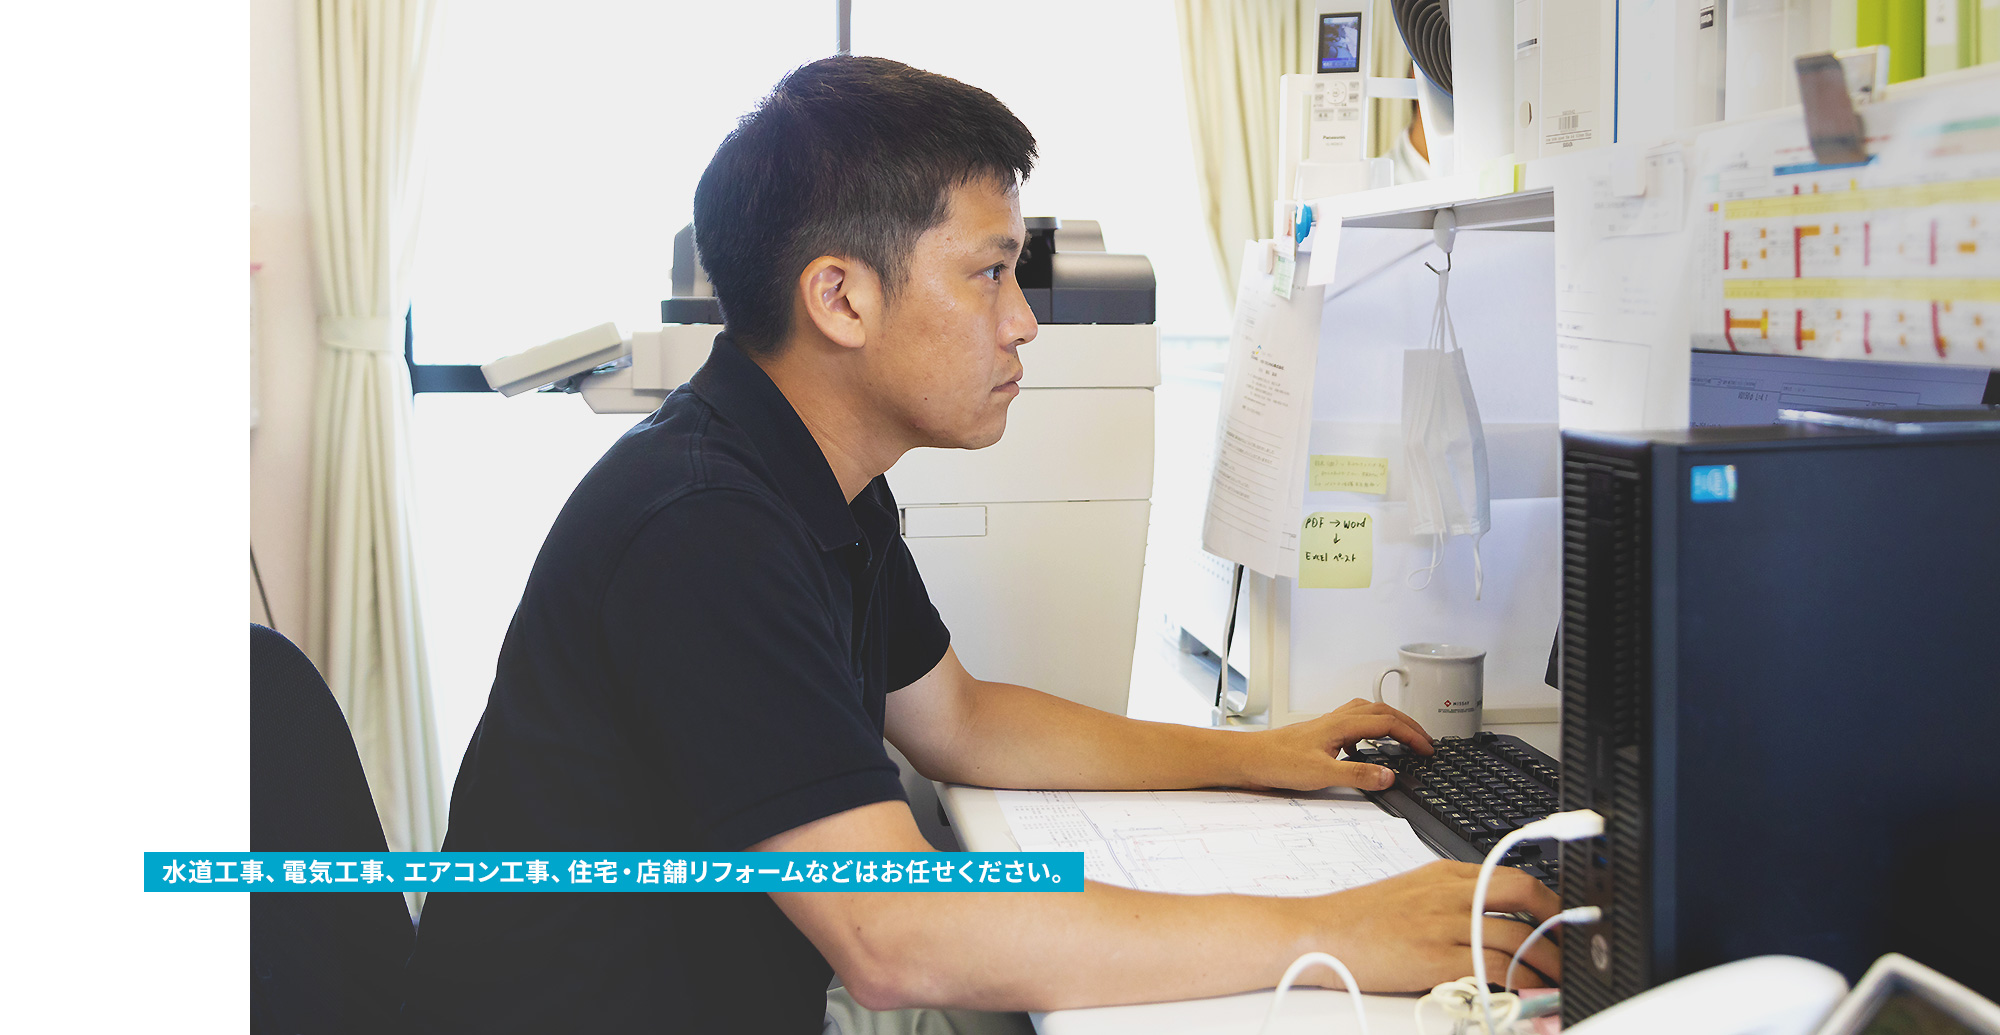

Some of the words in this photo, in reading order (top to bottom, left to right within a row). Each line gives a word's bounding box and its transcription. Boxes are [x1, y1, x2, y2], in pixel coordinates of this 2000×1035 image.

[1305, 517, 1325, 529] PDF
[1343, 517, 1367, 529] Word
[1305, 552, 1328, 562] Excel
